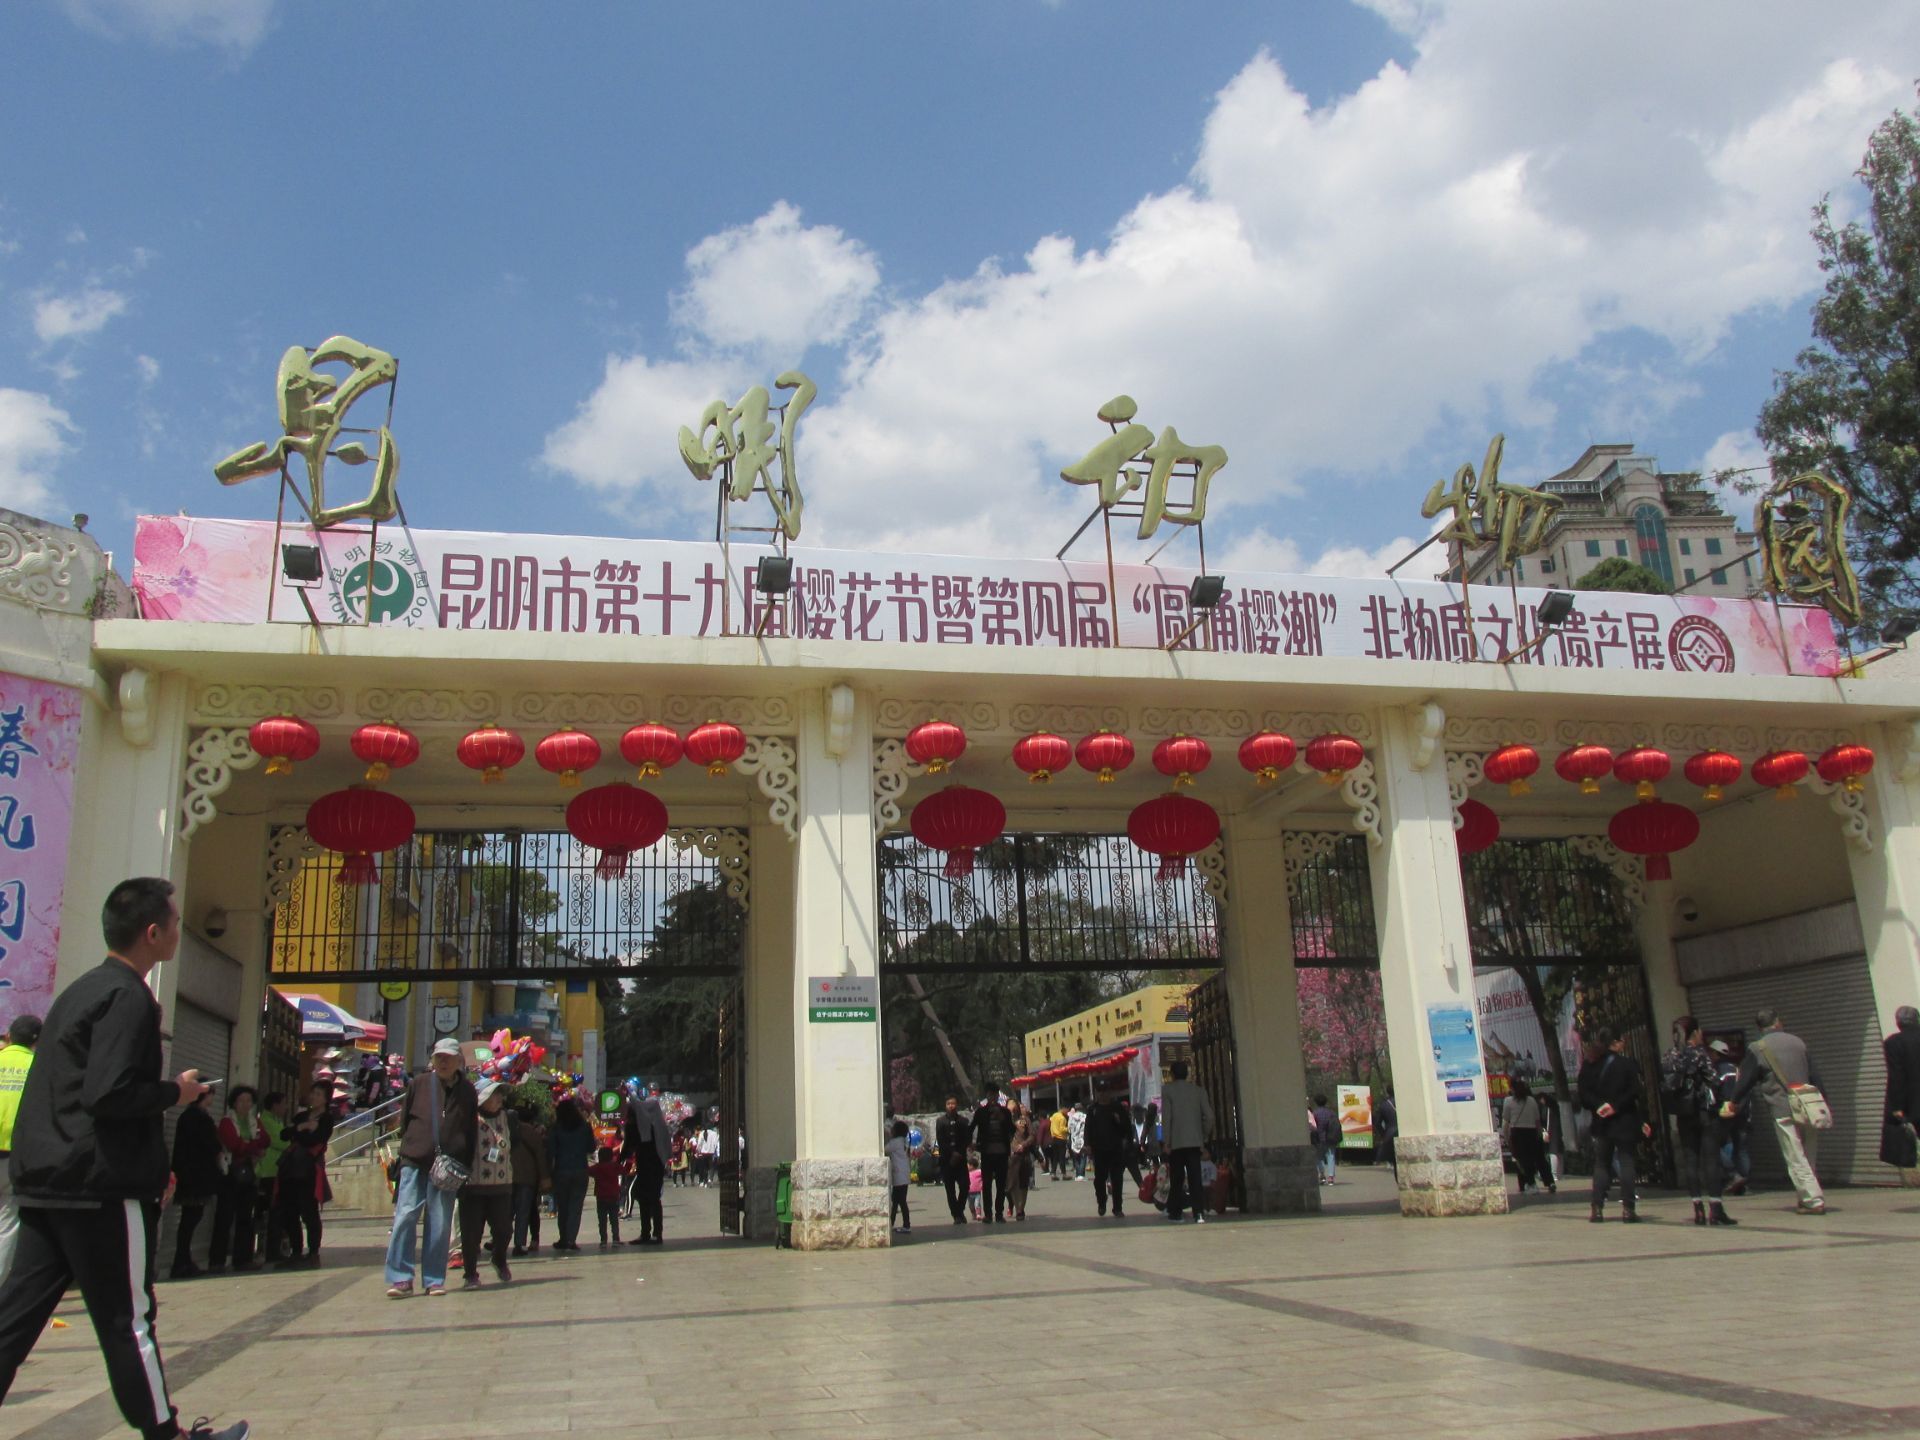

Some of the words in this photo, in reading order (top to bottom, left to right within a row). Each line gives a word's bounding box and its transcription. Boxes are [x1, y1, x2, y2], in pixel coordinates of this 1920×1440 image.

[330, 541, 429, 588] 昆明动物园
